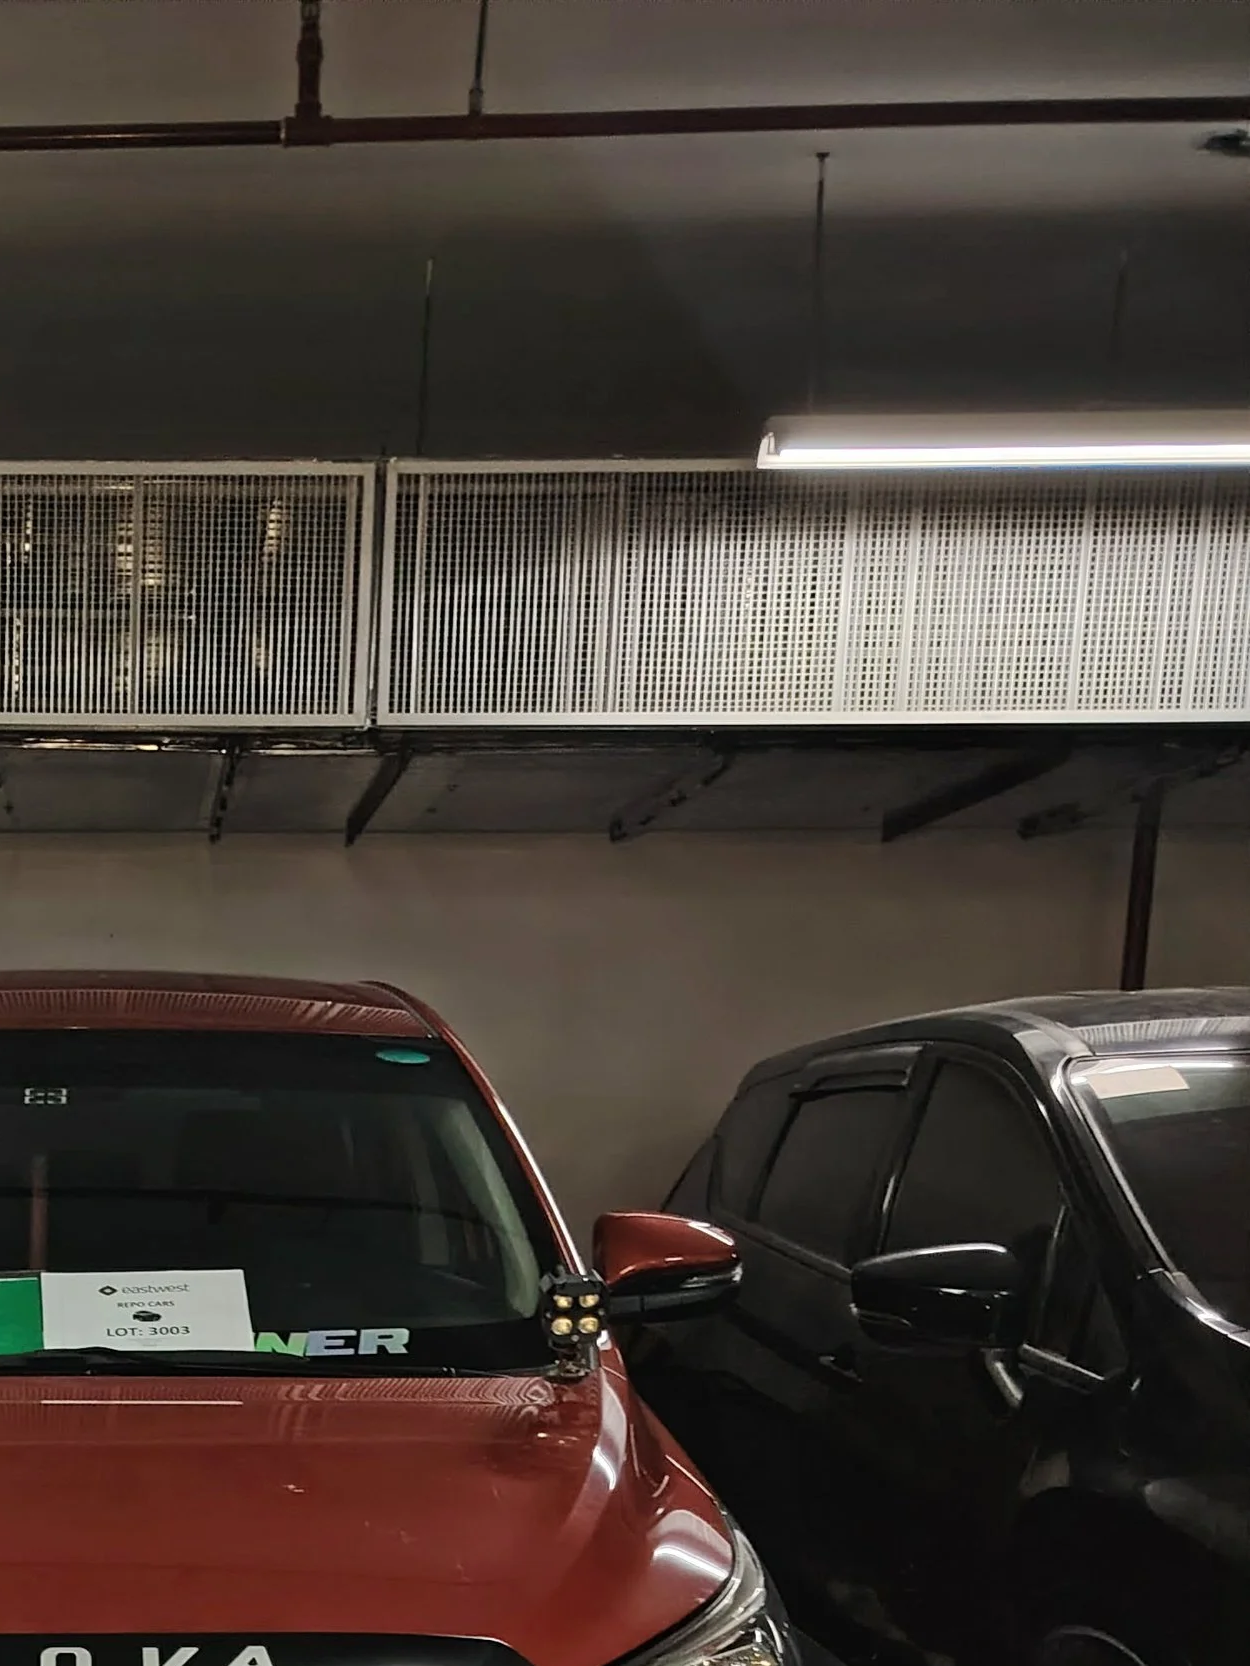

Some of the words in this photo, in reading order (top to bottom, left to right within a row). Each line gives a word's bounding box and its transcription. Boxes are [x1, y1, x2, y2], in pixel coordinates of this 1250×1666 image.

[122, 1283, 190, 1294] eastwest
[106, 1327, 143, 1337] LOT:
[149, 1326, 191, 1336] 3003
